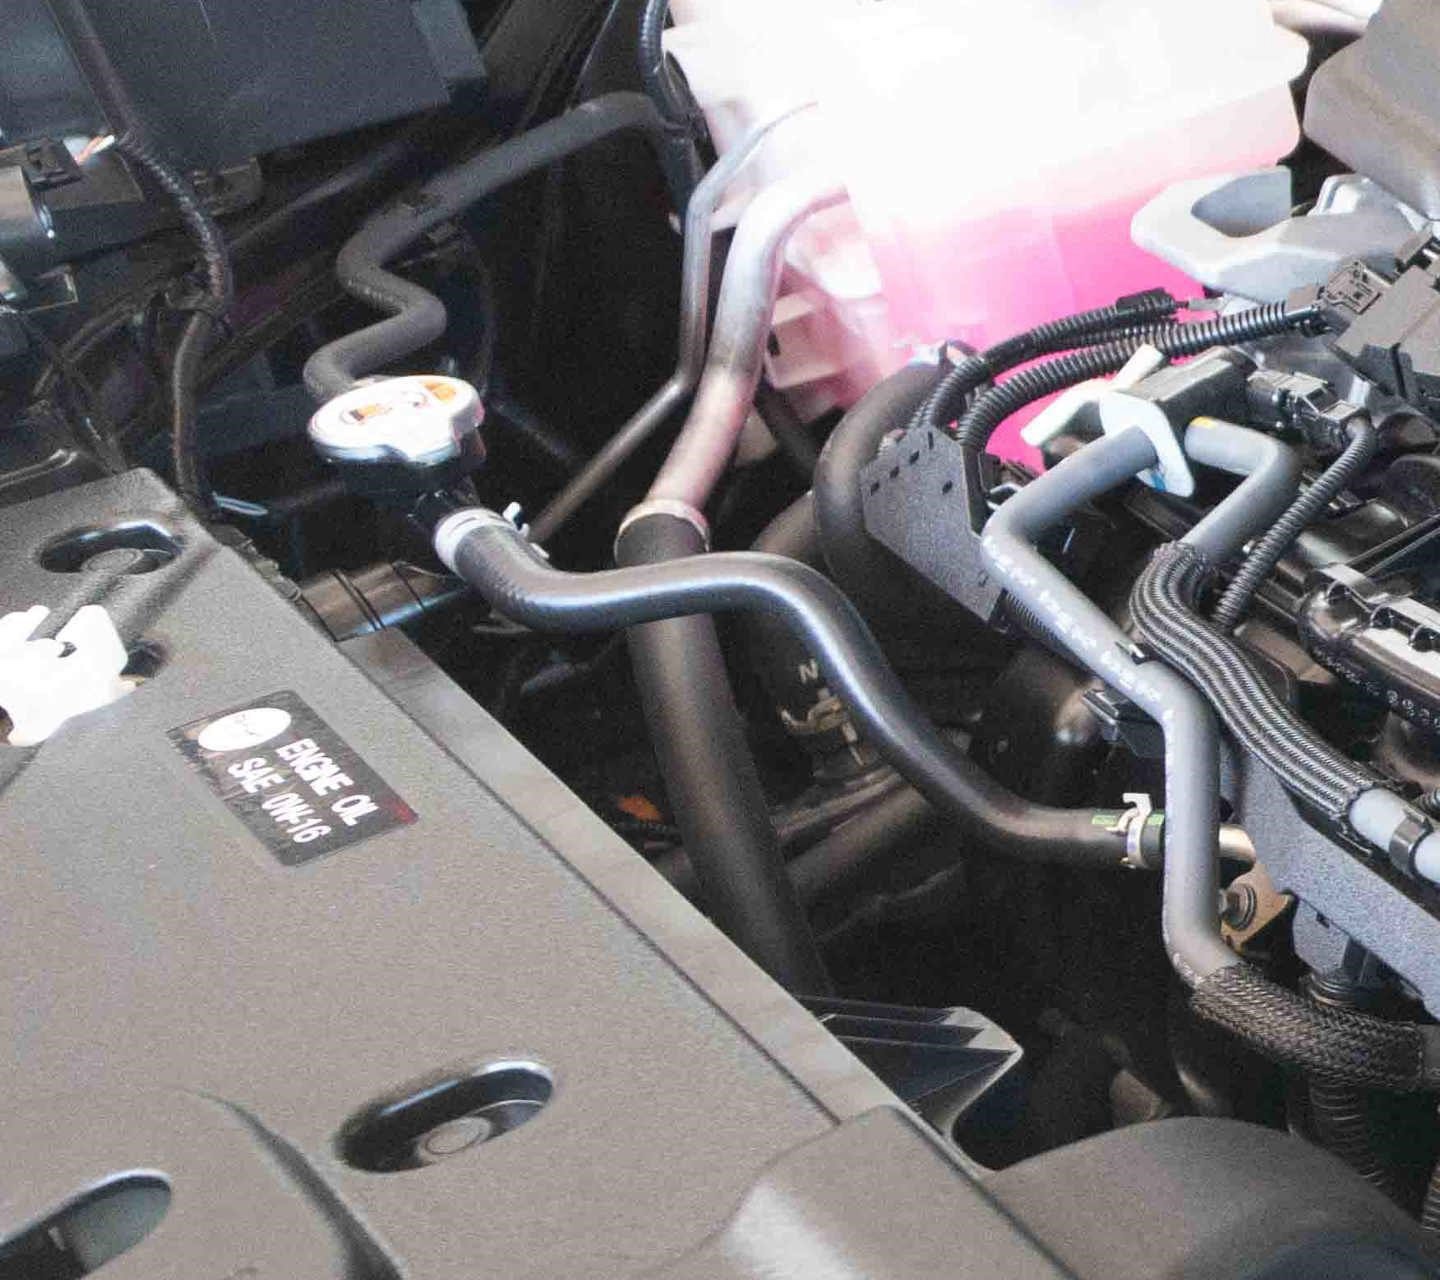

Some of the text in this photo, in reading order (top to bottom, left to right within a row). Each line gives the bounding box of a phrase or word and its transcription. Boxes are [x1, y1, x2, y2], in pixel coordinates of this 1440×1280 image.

[227, 757, 332, 844] SAE 0W-16
[275, 737, 380, 826] ENGINE OIL
